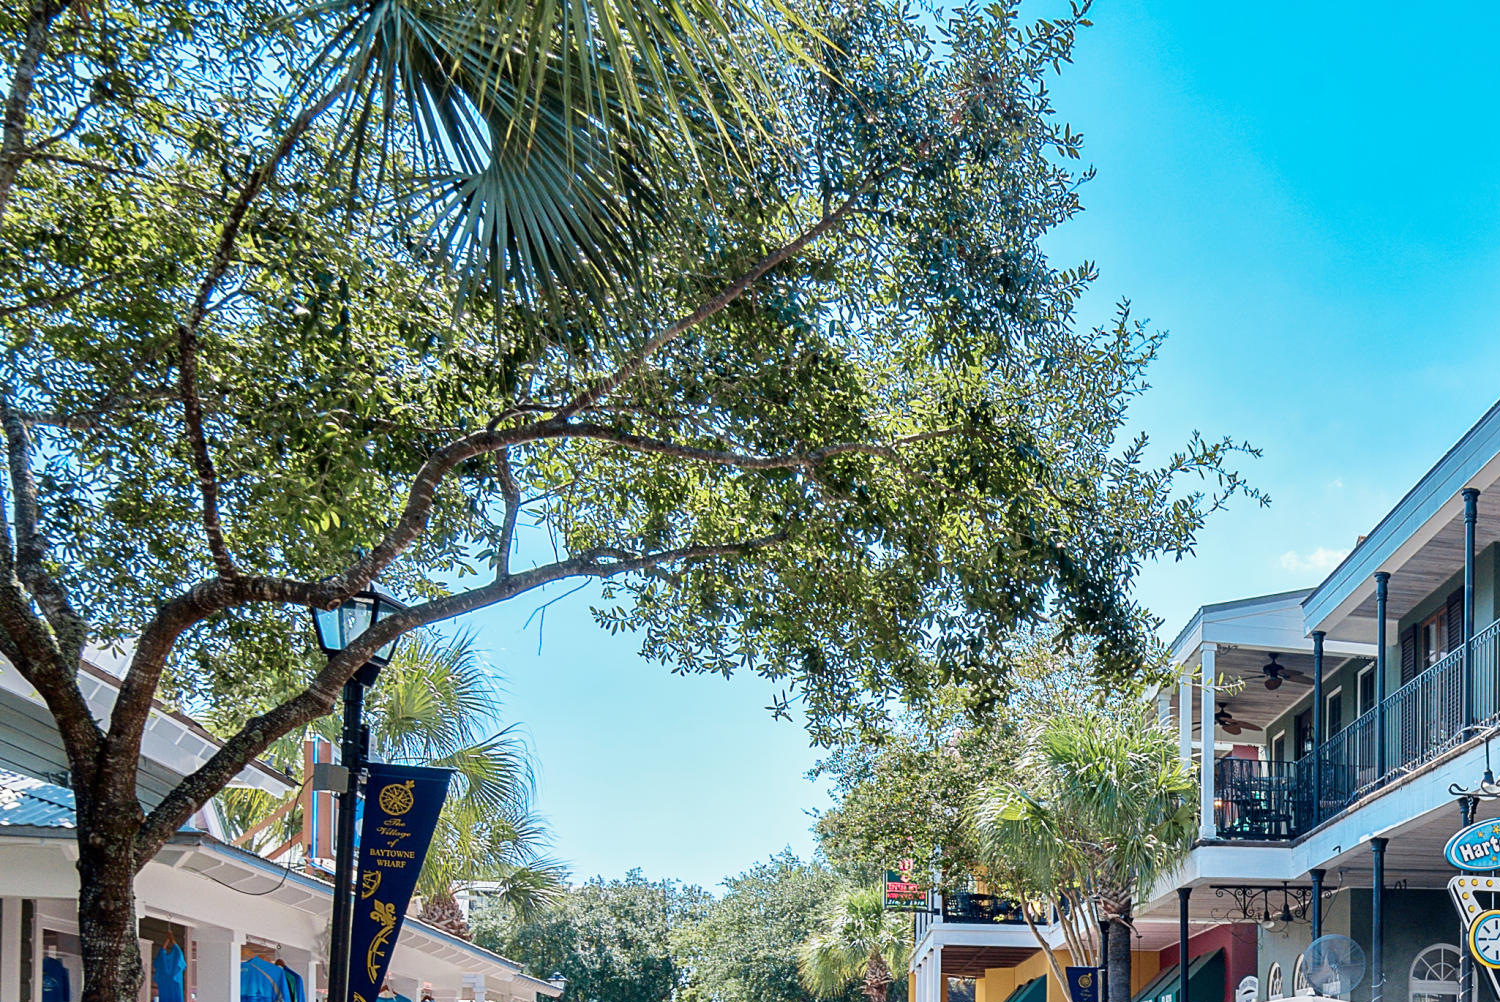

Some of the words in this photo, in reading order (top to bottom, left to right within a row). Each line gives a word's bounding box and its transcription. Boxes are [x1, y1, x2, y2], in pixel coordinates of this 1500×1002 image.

[383, 819, 406, 827] The
[376, 826, 411, 839] Village
[369, 848, 415, 859] BAYTOWNE
[377, 859, 406, 868] WHARF
